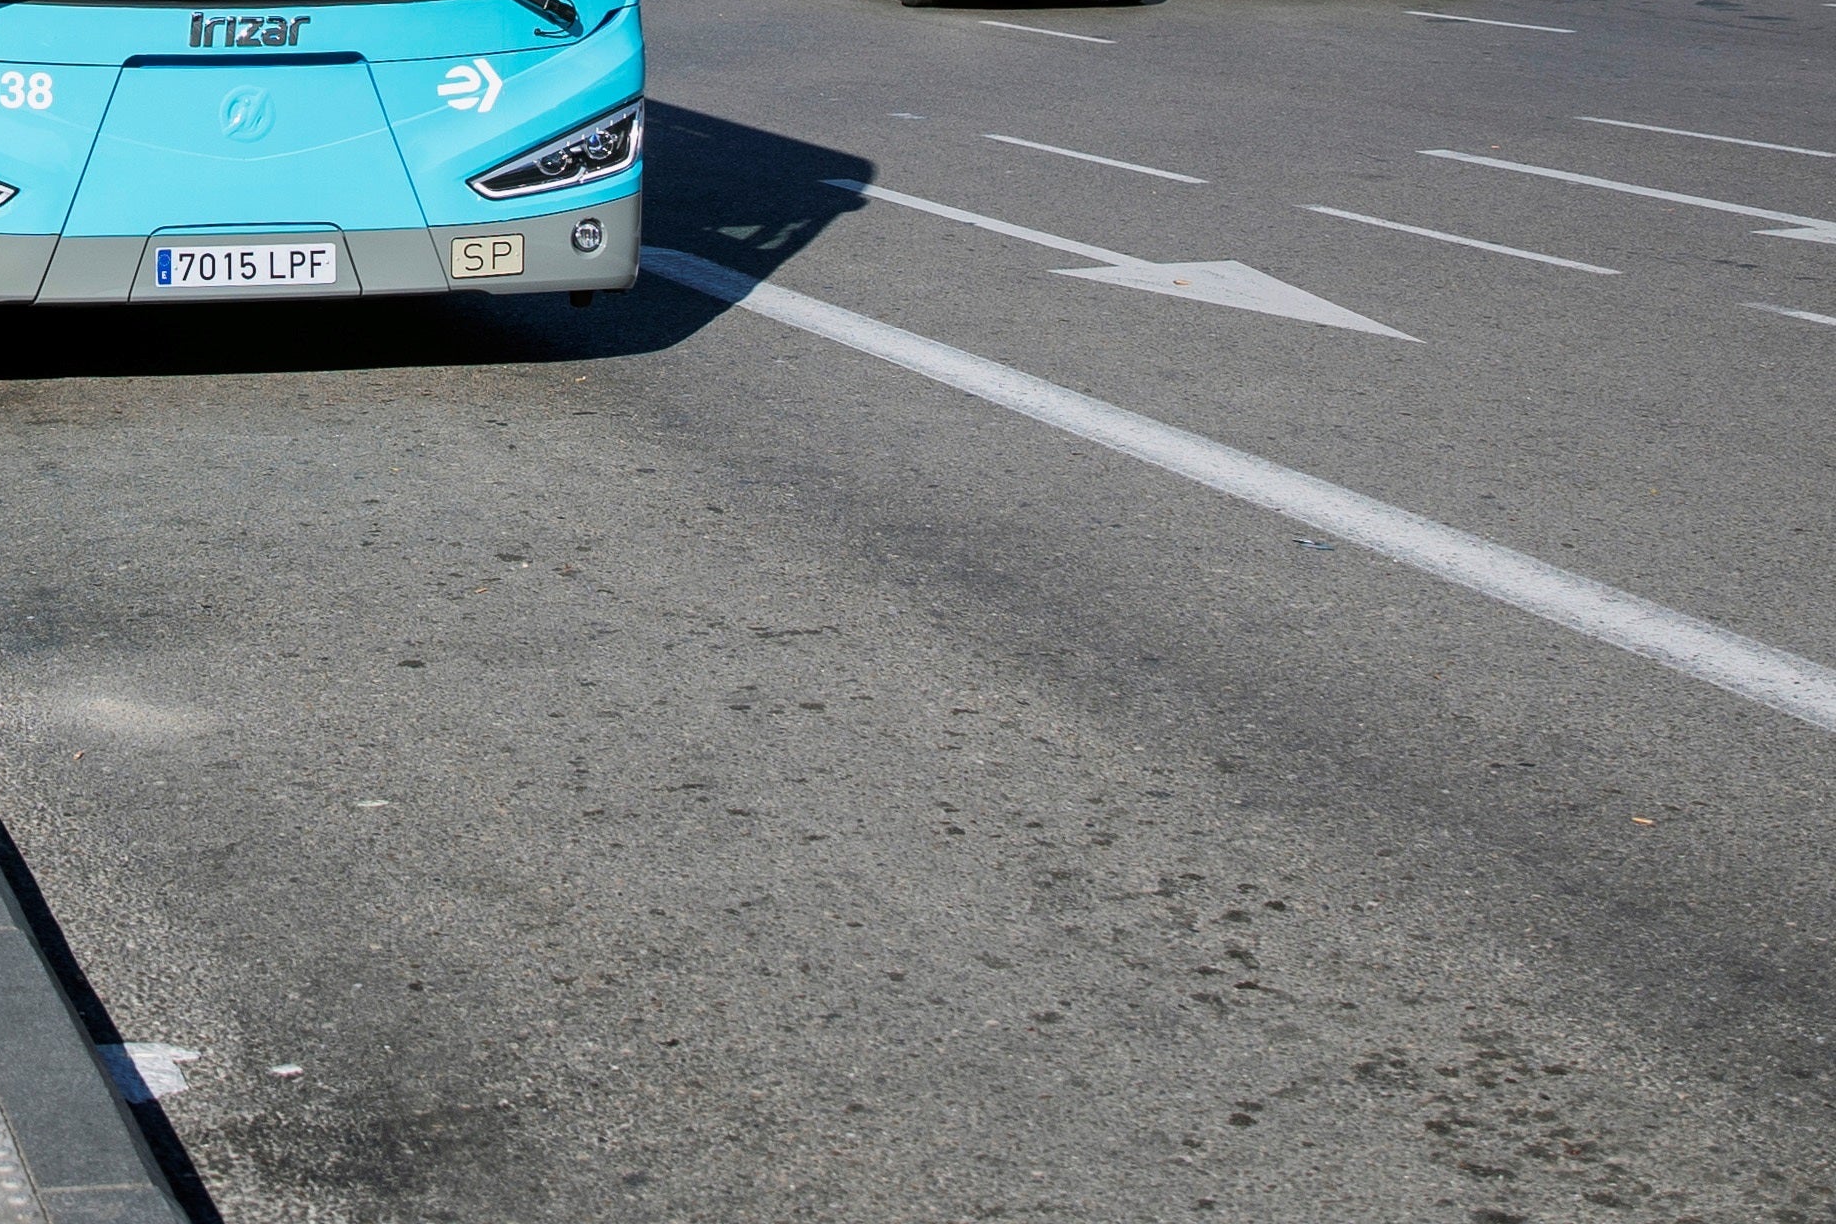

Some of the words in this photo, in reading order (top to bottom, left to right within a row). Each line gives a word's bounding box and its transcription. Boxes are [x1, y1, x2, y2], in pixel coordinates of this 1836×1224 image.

[178, 252, 257, 282] 7015
[269, 250, 327, 280] LPF
[463, 241, 512, 272] SP
[160, 270, 169, 281] E
